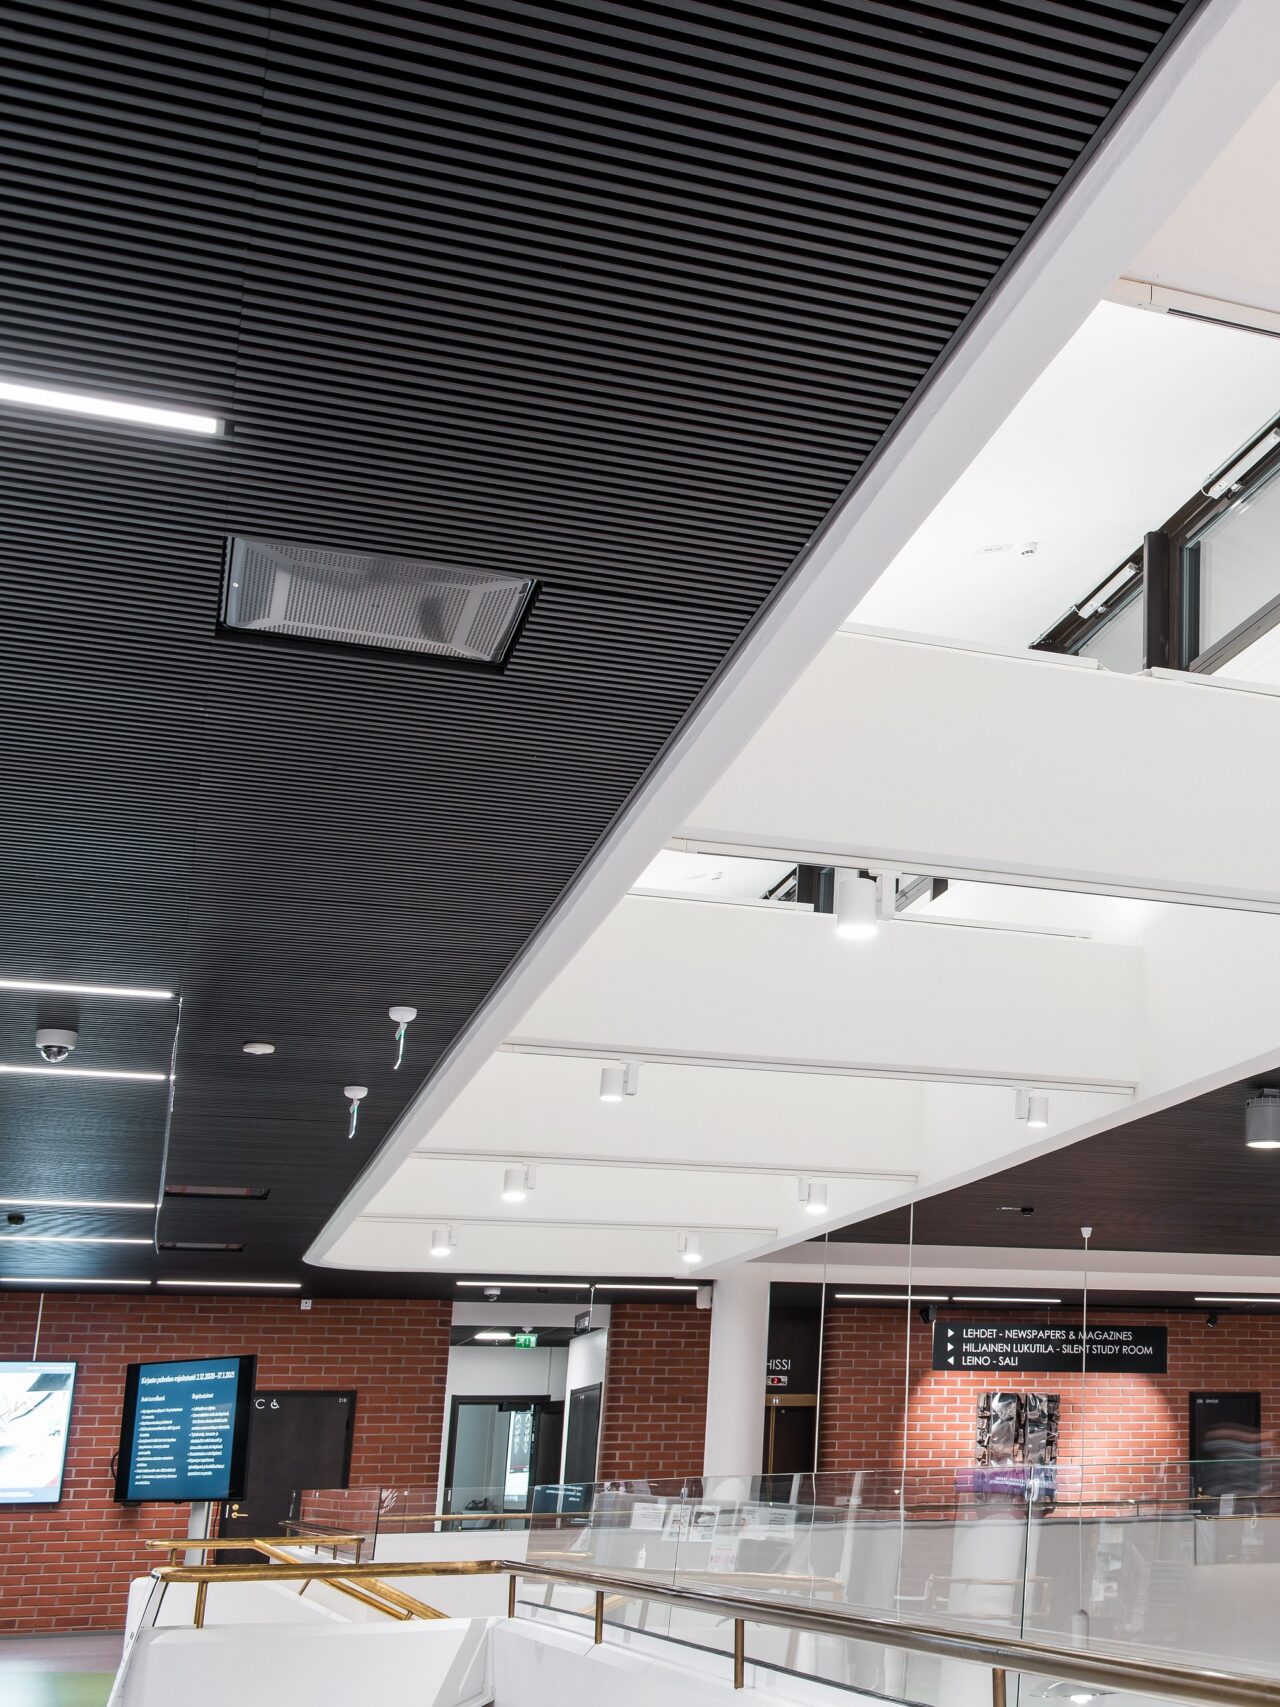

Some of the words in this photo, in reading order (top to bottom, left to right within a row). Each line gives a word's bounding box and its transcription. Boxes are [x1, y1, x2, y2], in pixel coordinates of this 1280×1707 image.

[963, 1328, 998, 1339] LEHDET
[1005, 1329, 1066, 1340] NEWSPAPERS
[1068, 1330, 1076, 1340] &
[1078, 1331, 1133, 1341] MAGAZINES
[962, 1342, 1011, 1353] HILJAINEN
[1013, 1343, 1054, 1354] LUKUTILA
[1062, 1344, 1090, 1354] SILENT
[1092, 1344, 1120, 1354] STUDY
[1122, 1345, 1153, 1355] ROOM
[962, 1356, 991, 1366] LEINO
[998, 1356, 1018, 1366] SALI
